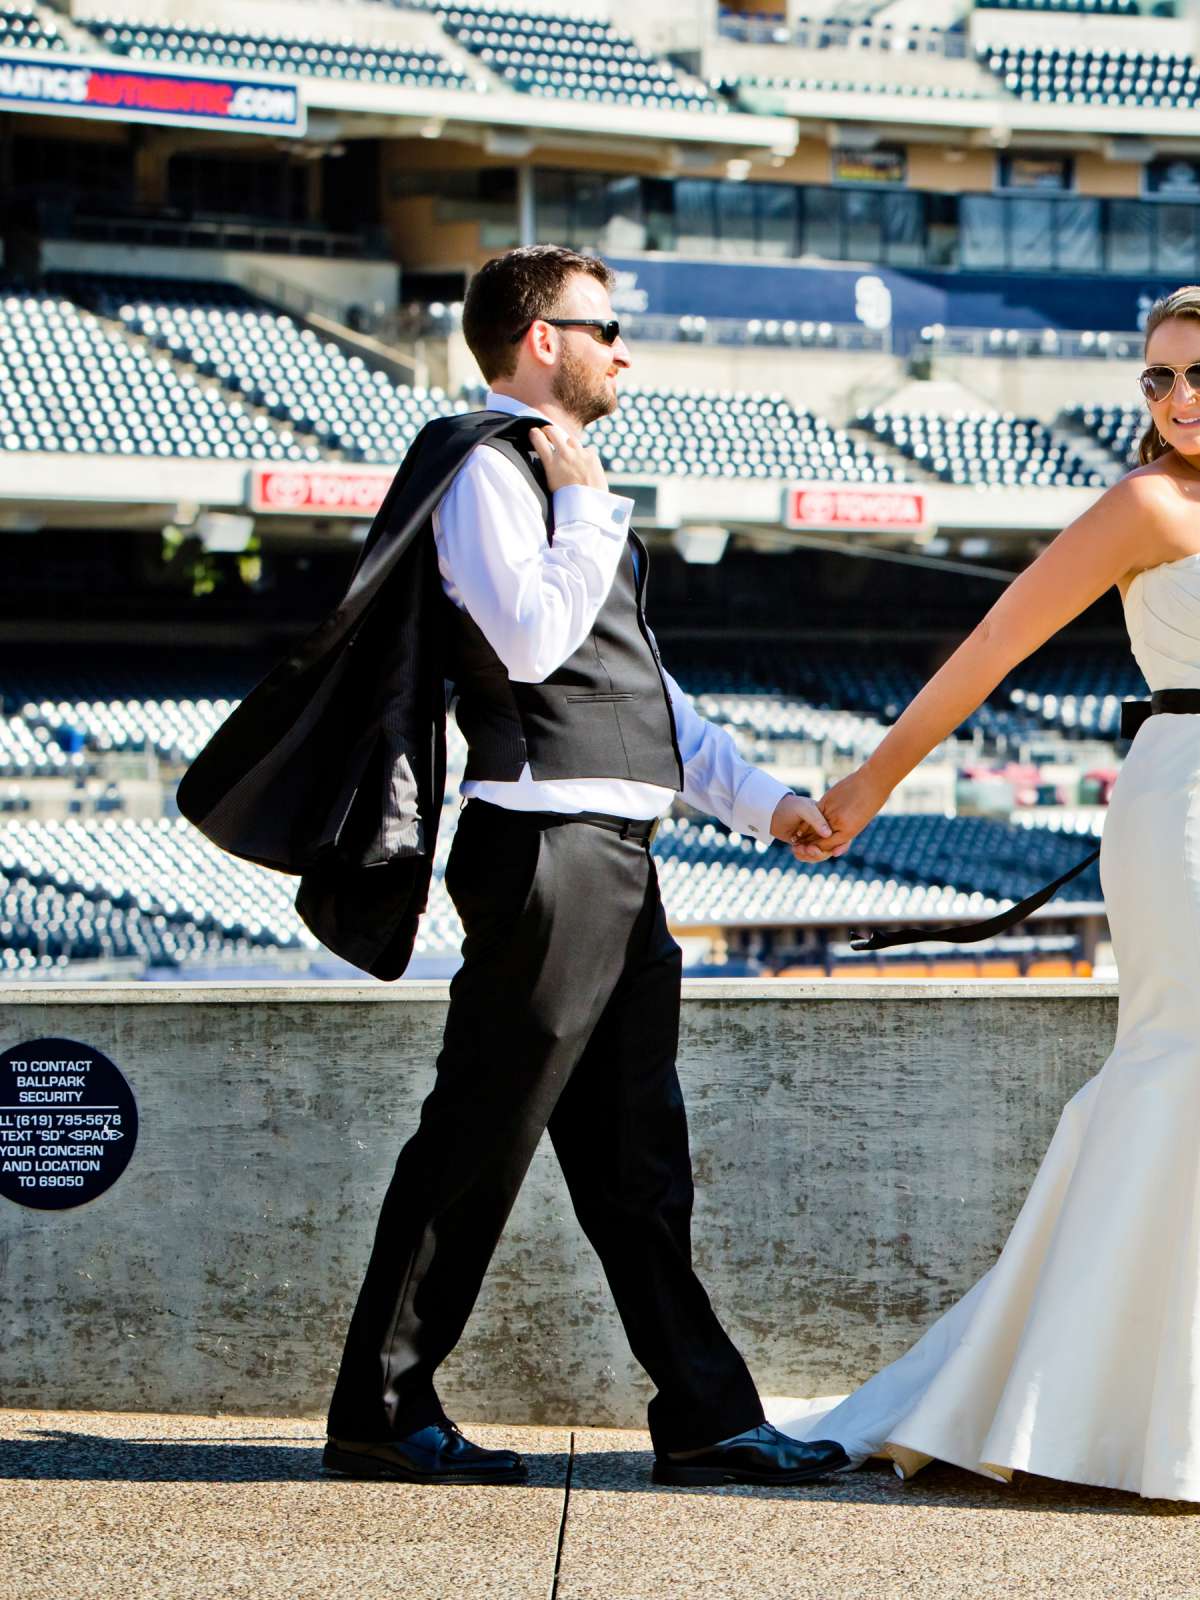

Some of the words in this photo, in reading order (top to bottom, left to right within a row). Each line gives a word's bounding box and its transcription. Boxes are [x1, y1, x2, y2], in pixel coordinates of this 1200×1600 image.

[10, 1061, 27, 1072] TO
[30, 1061, 92, 1072] CONTACT
[17, 1076, 85, 1087] BALLPARK
[19, 1091, 83, 1102] SECURITY
[16, 1115, 53, 1129] (619)
[56, 1115, 121, 1126] 795-5678
[1, 1130, 33, 1141] TEXT
[0, 1145, 36, 1157] YOUR
[39, 1145, 104, 1157] CONCERN
[2, 1161, 32, 1172] AND
[35, 1160, 100, 1172] LOCATION
[18, 1176, 36, 1187] TO
[39, 1176, 84, 1187] 69050
